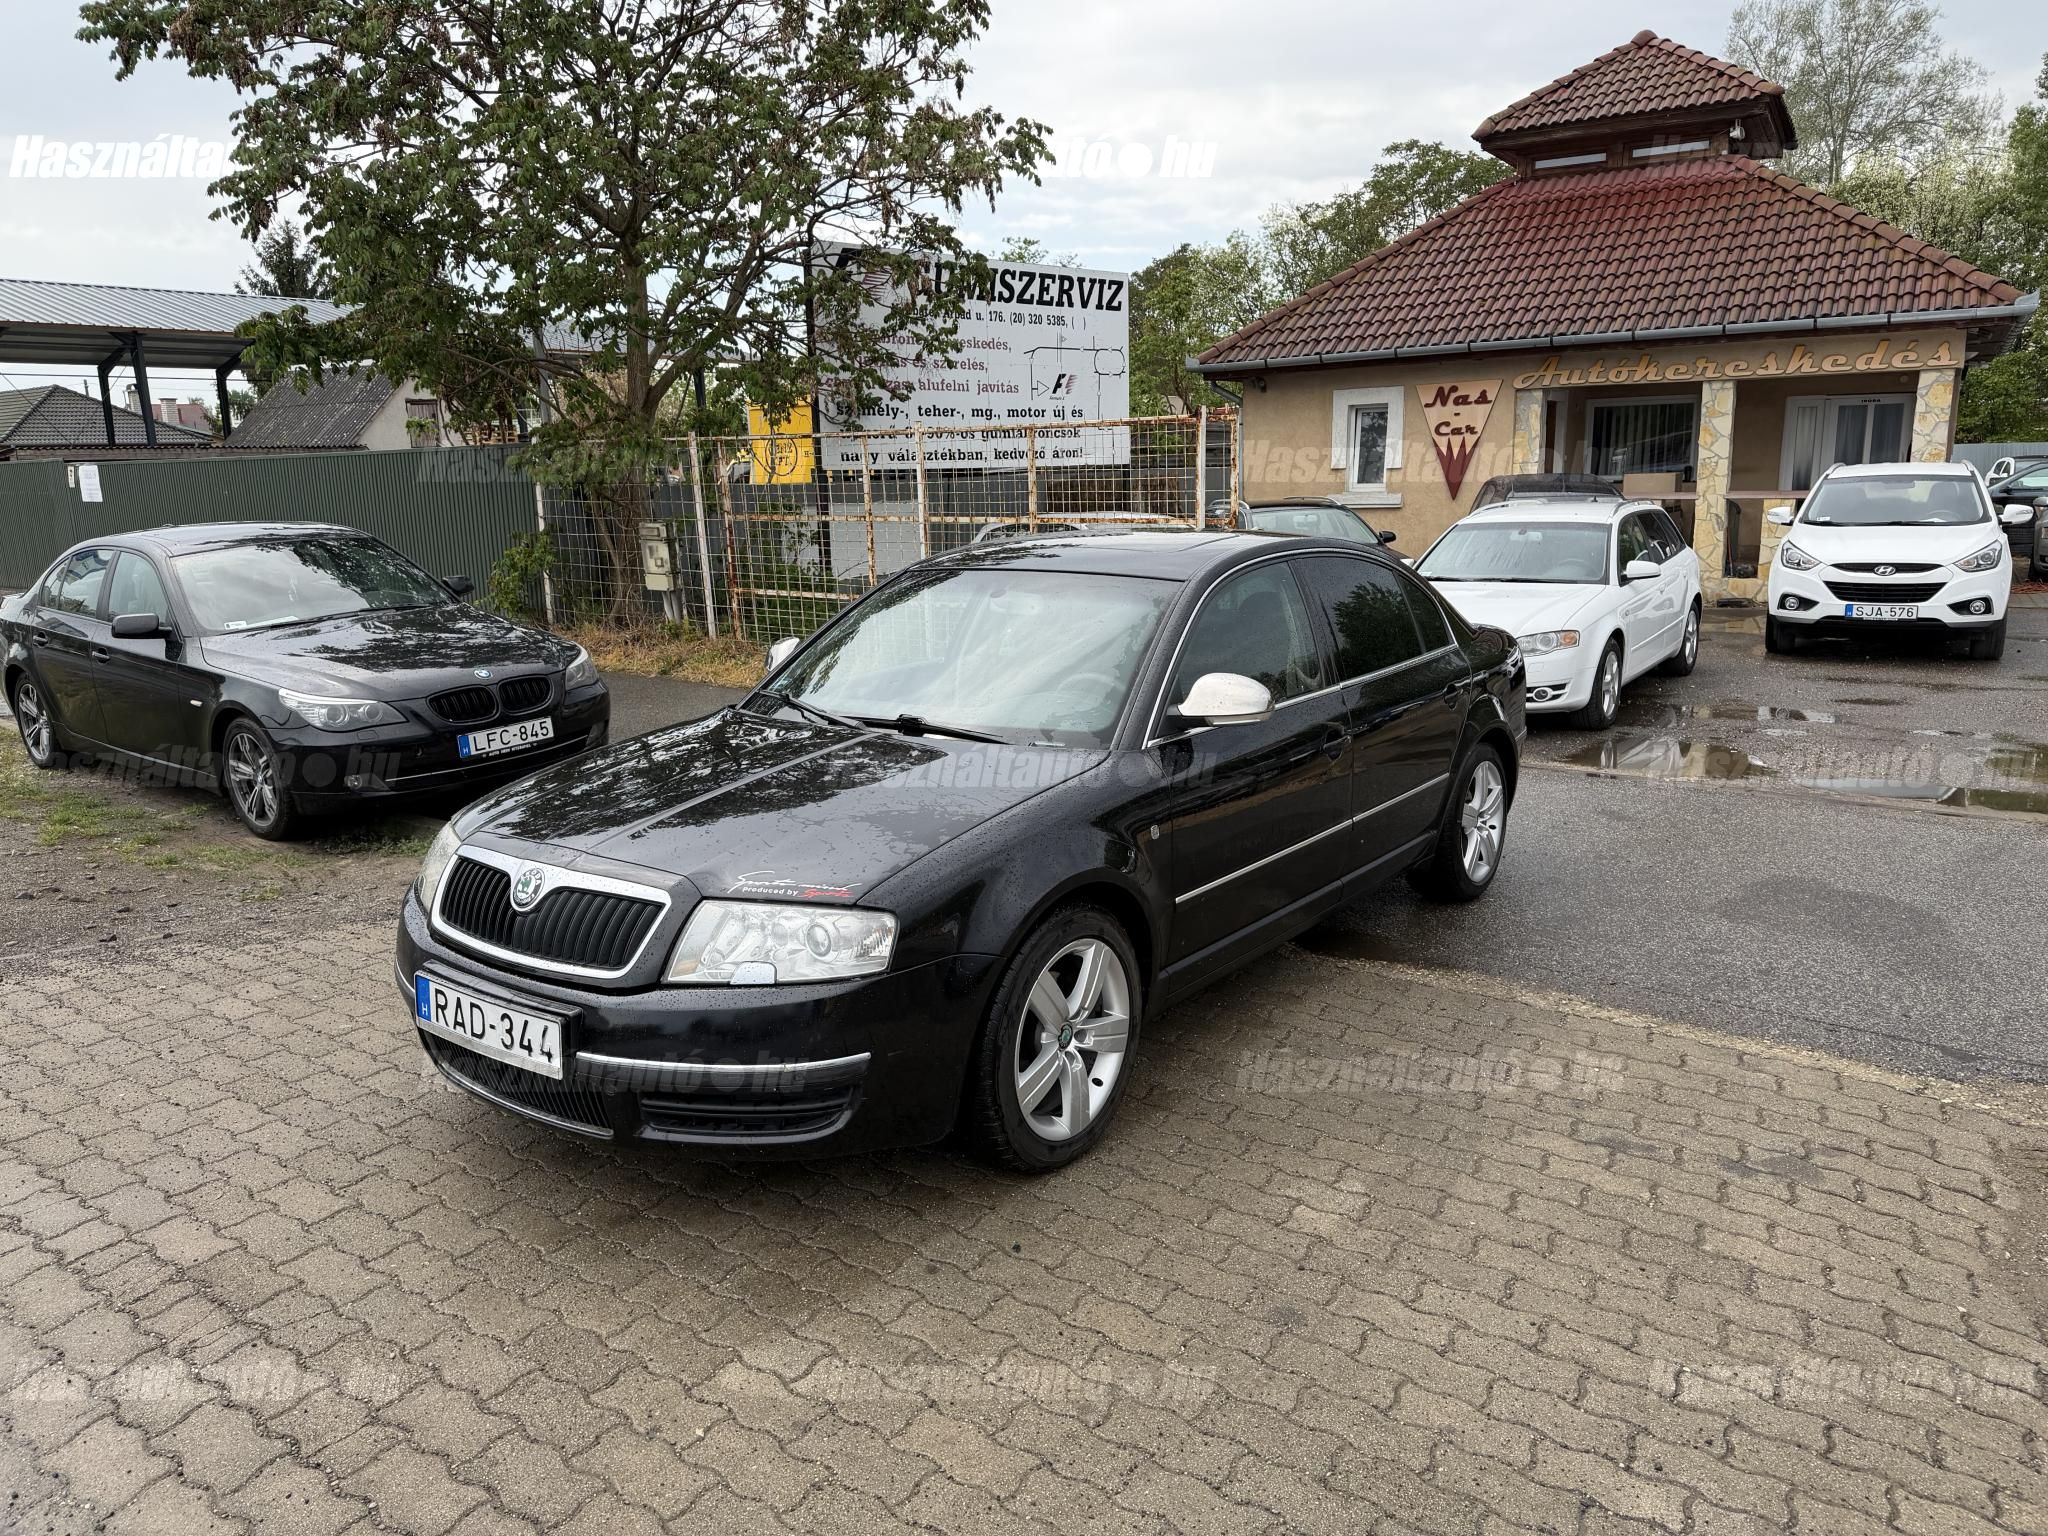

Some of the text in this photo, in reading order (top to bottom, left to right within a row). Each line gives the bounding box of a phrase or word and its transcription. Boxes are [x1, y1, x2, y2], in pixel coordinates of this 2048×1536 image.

[975, 312, 984, 320] u.
[989, 310, 1006, 323] 176.
[1009, 312, 1025, 326] (20)
[1028, 313, 1043, 325] 320
[1047, 314, 1068, 328] 5385,
[933, 357, 988, 373] szrelés,
[1513, 340, 1958, 390] Autókereskedés
[919, 378, 970, 392] alufelni
[977, 379, 1019, 395] javítás
[1424, 385, 1493, 408] Nas
[836, 402, 1084, 420] szmély-, teher-, mg., motor új és
[981, 426, 1081, 442] gumiaroncsok
[1434, 421, 1478, 436] Car
[840, 452, 879, 465] nay
[888, 447, 988, 462] válaztékban,
[1855, 606, 1914, 617] SJA-576
[473, 720, 549, 752] LFC-845
[742, 886, 785, 895] produced
[421, 988, 553, 1063] H RAD-344
